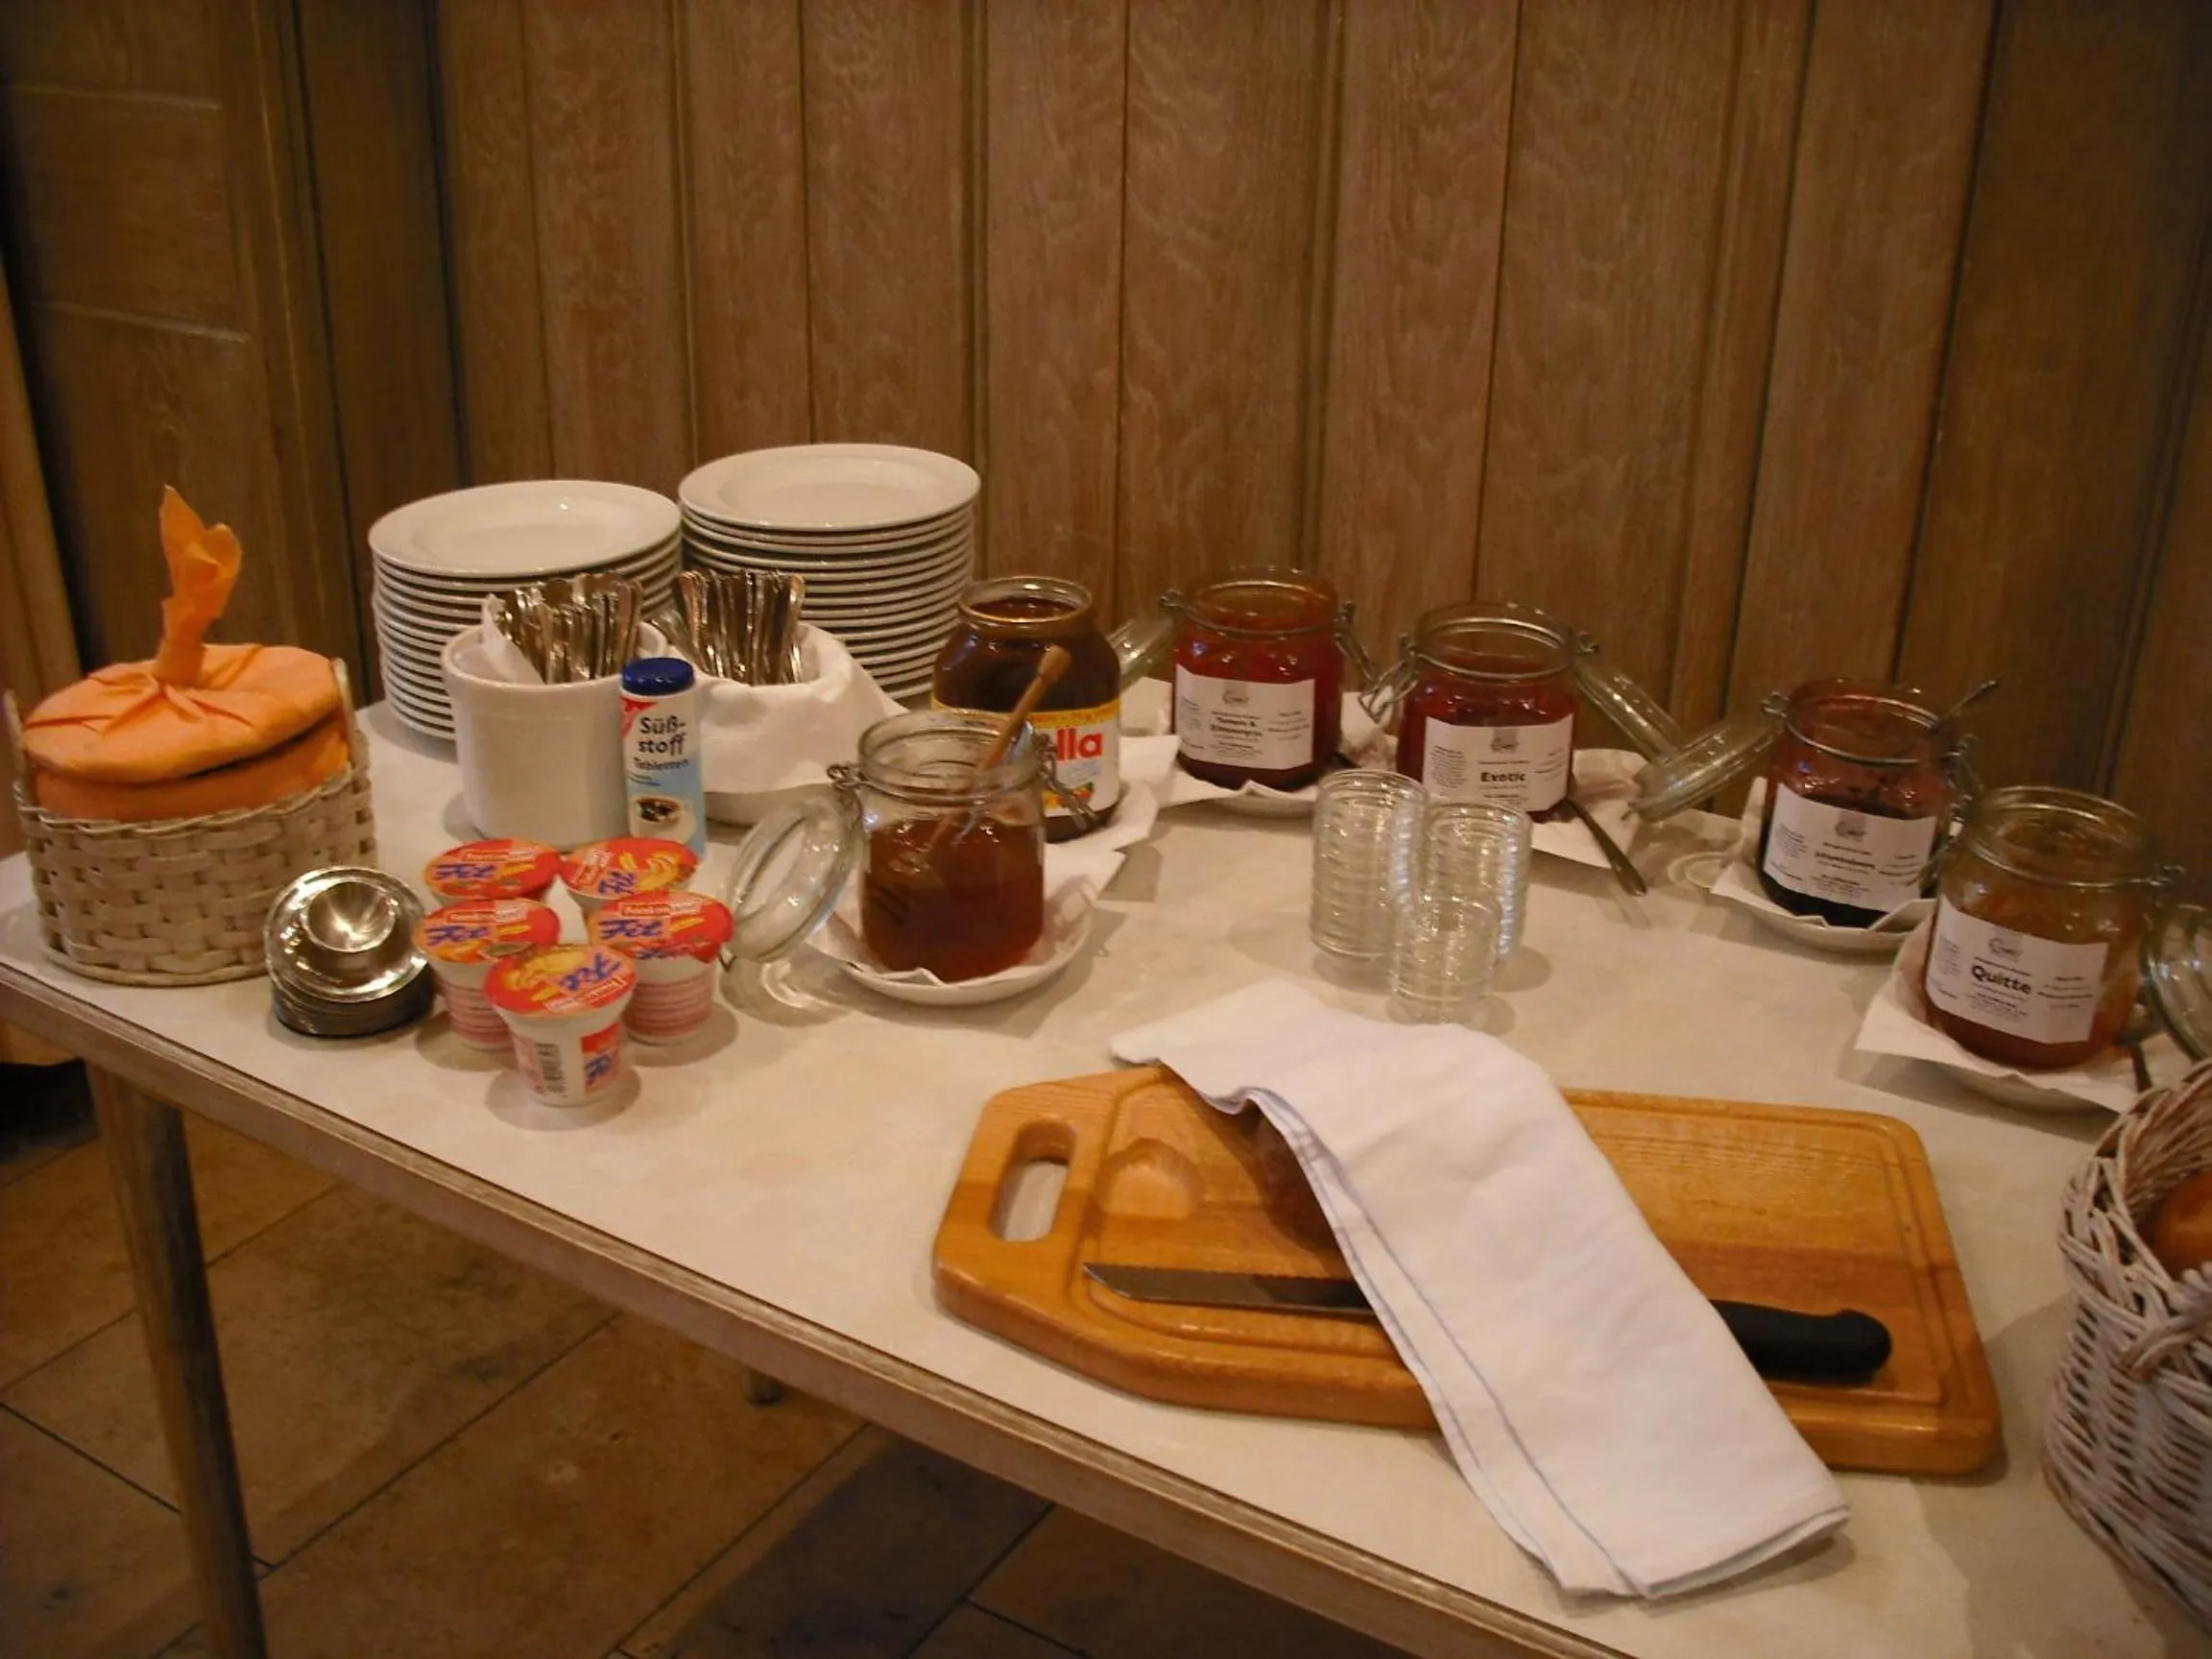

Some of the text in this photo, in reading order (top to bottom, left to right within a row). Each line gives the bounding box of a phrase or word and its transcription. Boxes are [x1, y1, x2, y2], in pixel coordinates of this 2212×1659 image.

[637, 732, 687, 757] stoff
[1056, 728, 1103, 761] lla
[1480, 771, 1527, 782] Exotic
[1970, 964, 2033, 995] Quitte
